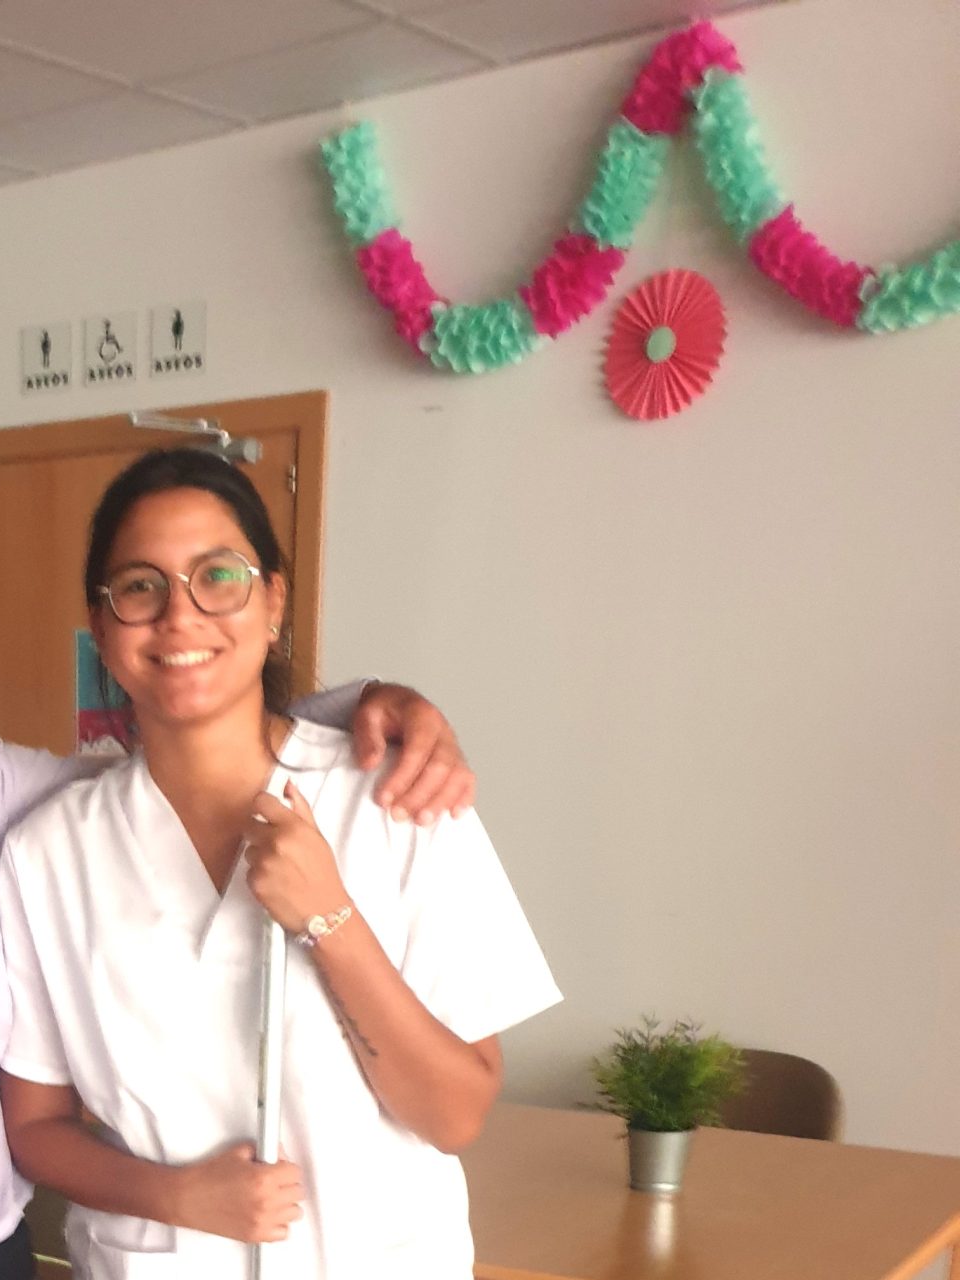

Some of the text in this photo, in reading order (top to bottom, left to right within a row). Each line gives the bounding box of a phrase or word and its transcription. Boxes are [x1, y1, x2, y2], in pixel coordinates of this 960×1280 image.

[88, 363, 133, 382] ASEOS
[155, 353, 203, 373] ASEOS
[26, 373, 69, 390] ASEOS
